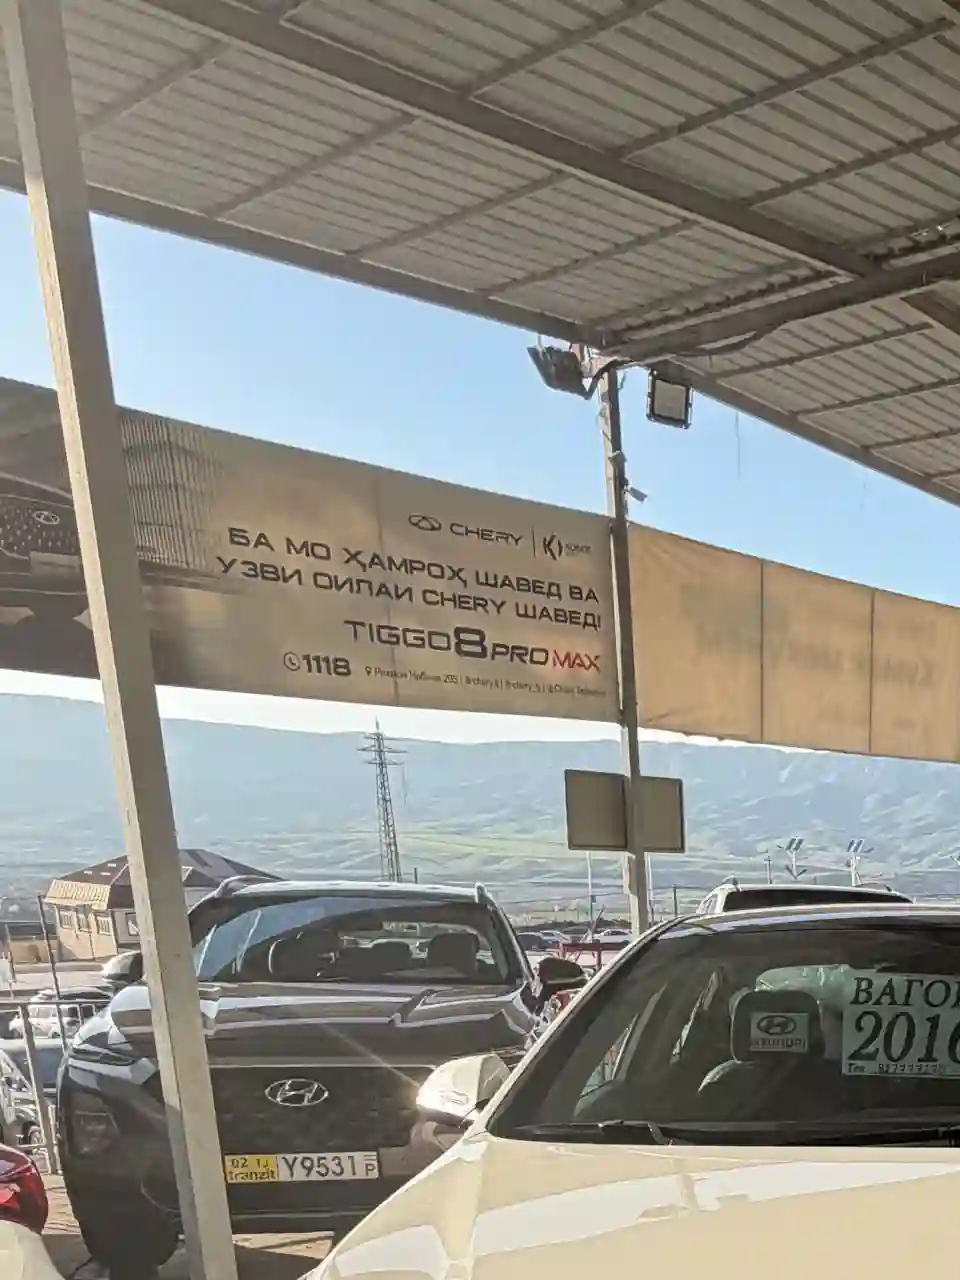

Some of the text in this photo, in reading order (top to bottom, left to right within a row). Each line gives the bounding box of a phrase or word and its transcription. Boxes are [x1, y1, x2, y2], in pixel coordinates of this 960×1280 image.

[450, 523, 524, 546] CHERY
[228, 527, 275, 552] БА
[285, 537, 331, 561] МО
[475, 569, 562, 600] ШАВЕД
[569, 585, 599, 604] ВА
[216, 556, 303, 586] УЗВИ
[422, 588, 507, 615] CHERY
[302, 653, 352, 676] 1118
[553, 649, 601, 672] MAX
[231, 1157, 248, 1168] 02
[282, 1155, 356, 1178] Y9531
[228, 1169, 276, 1181] tranzit
